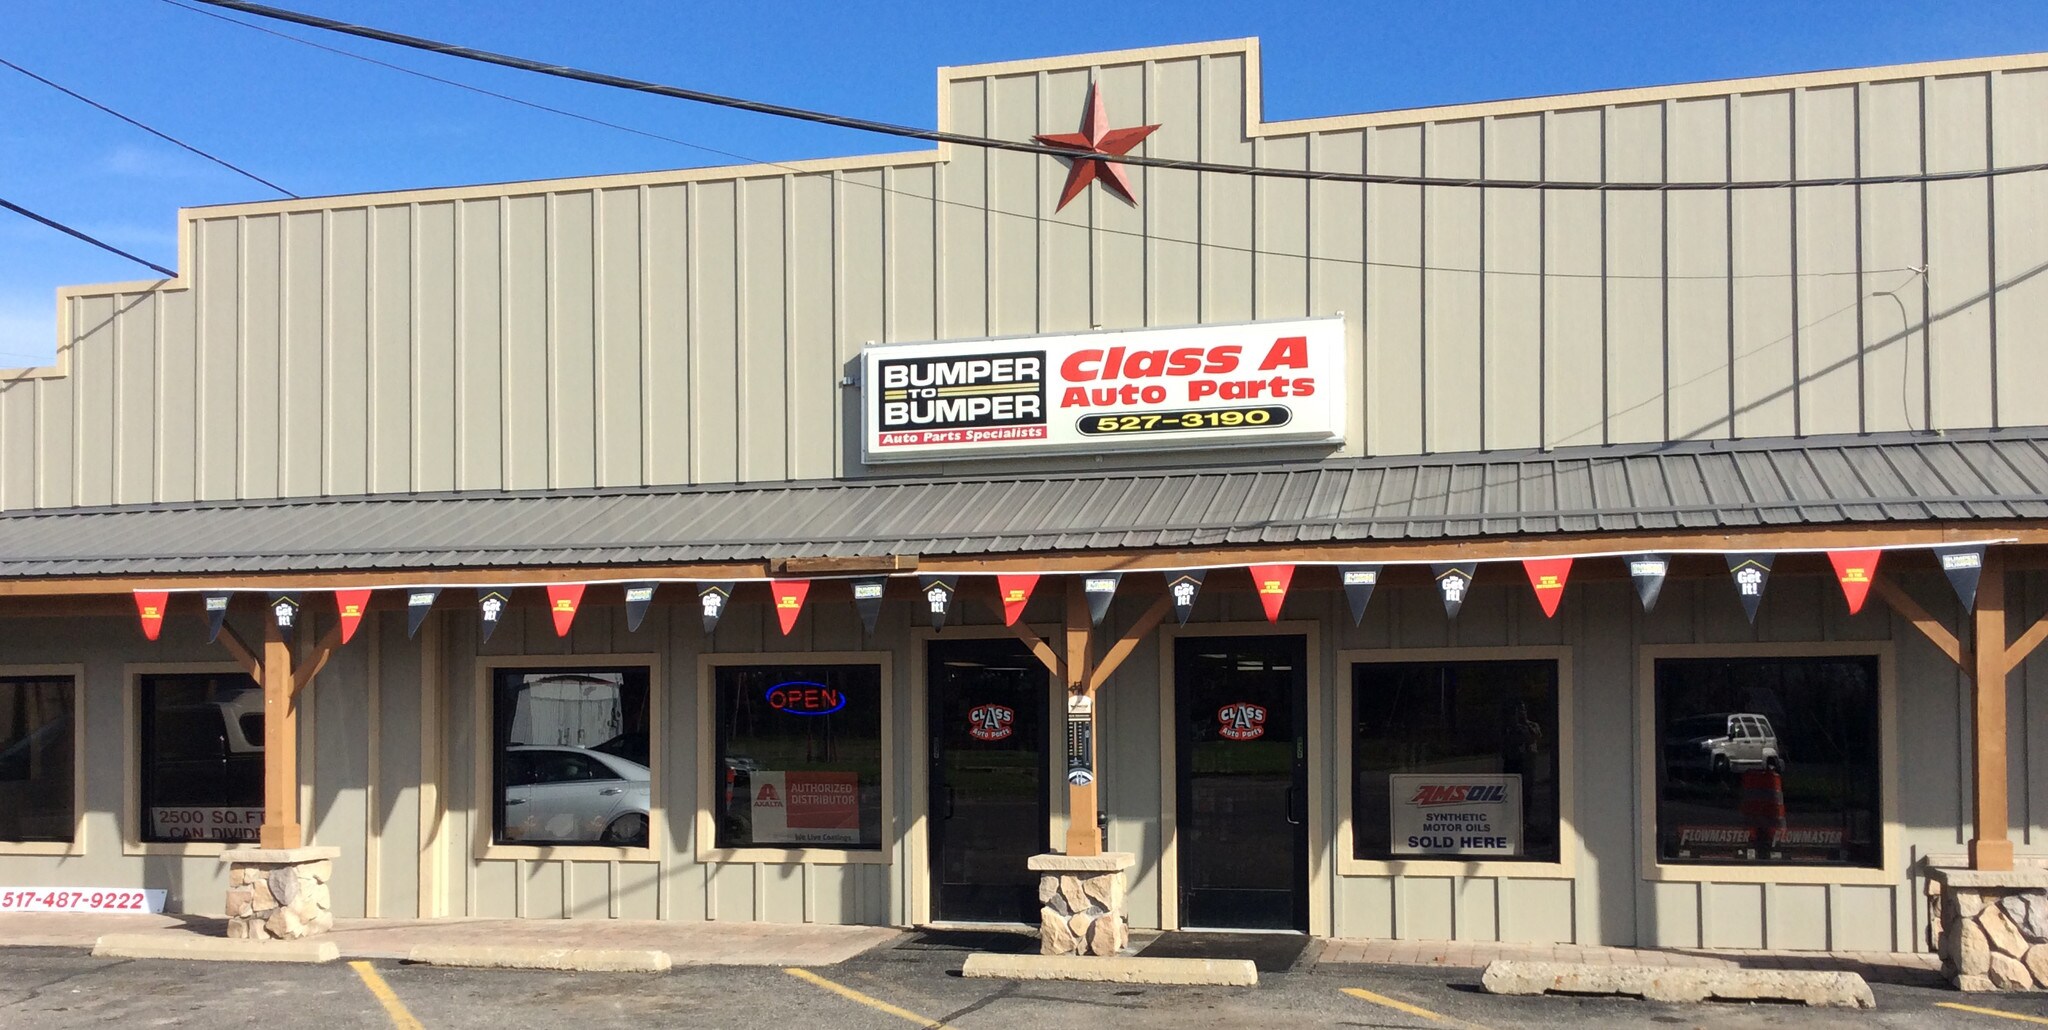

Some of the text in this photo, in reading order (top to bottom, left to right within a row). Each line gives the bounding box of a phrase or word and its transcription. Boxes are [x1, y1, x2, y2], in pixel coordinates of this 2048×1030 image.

[1060, 336, 1308, 382] Class A
[885, 357, 1040, 388] BUMPER
[908, 388, 937, 399] TO
[1060, 376, 1315, 408] Auto Parts
[885, 394, 1040, 425] BUMPER
[1096, 410, 1270, 431] 527-3190
[882, 426, 1042, 445] Auto Parts Specialists
[1738, 571, 1761, 584] Get
[1442, 579, 1464, 590] Get
[928, 591, 947, 602] Get
[1175, 585, 1194, 597] Get
[483, 601, 501, 611] Get
[703, 596, 721, 606] Get
[276, 606, 292, 616] Get
[770, 689, 838, 708] OPEN
[973, 728, 989, 738] Auto
[1223, 727, 1240, 737] Auto
[790, 783, 851, 793] AUTHORIZED
[791, 794, 856, 805] DISTRIBUTOR
[1411, 785, 1504, 806] AMSOIL
[753, 800, 784, 808] AXALTA
[160, 810, 204, 824] 2500
[1426, 813, 1487, 822] SYNTHETIC
[170, 827, 204, 840] CAN
[1423, 823, 1491, 832] MOTOR OILS
[1408, 836, 1507, 848] SOLD HERE
[1680, 829, 1751, 845] FLOWMASTER
[1771, 830, 1843, 847] FLOWMASTER
[2, 892, 144, 909] 517-487-9222
